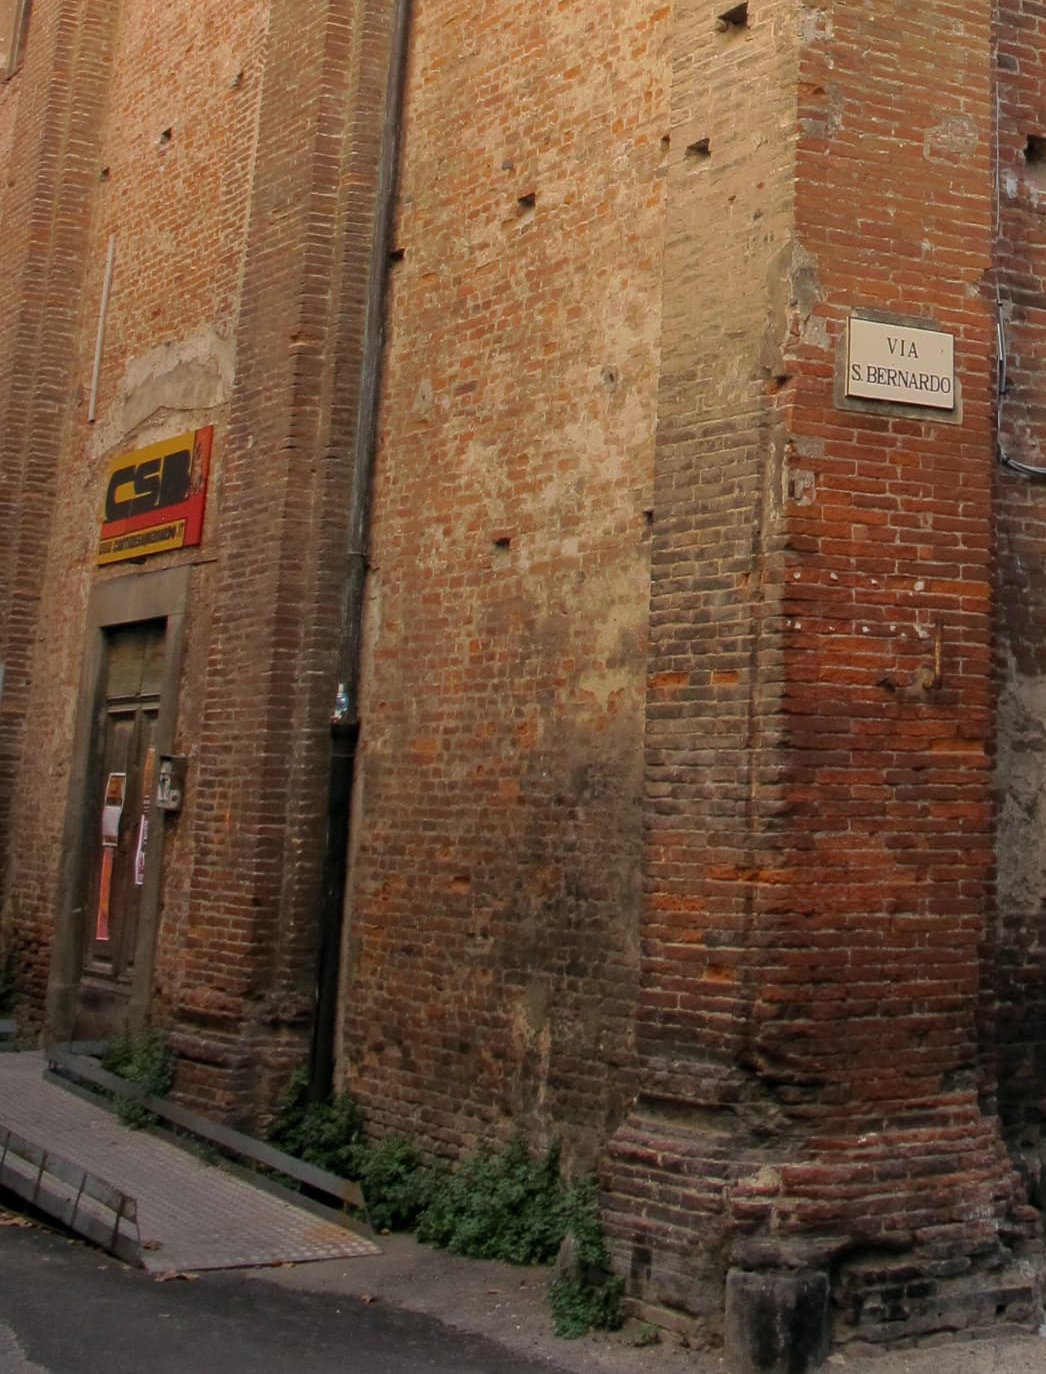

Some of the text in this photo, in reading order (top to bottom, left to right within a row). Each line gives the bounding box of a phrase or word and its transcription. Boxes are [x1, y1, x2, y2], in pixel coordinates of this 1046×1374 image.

[887, 337, 919, 359] VIA
[851, 364, 951, 394] S. BERNARDO
